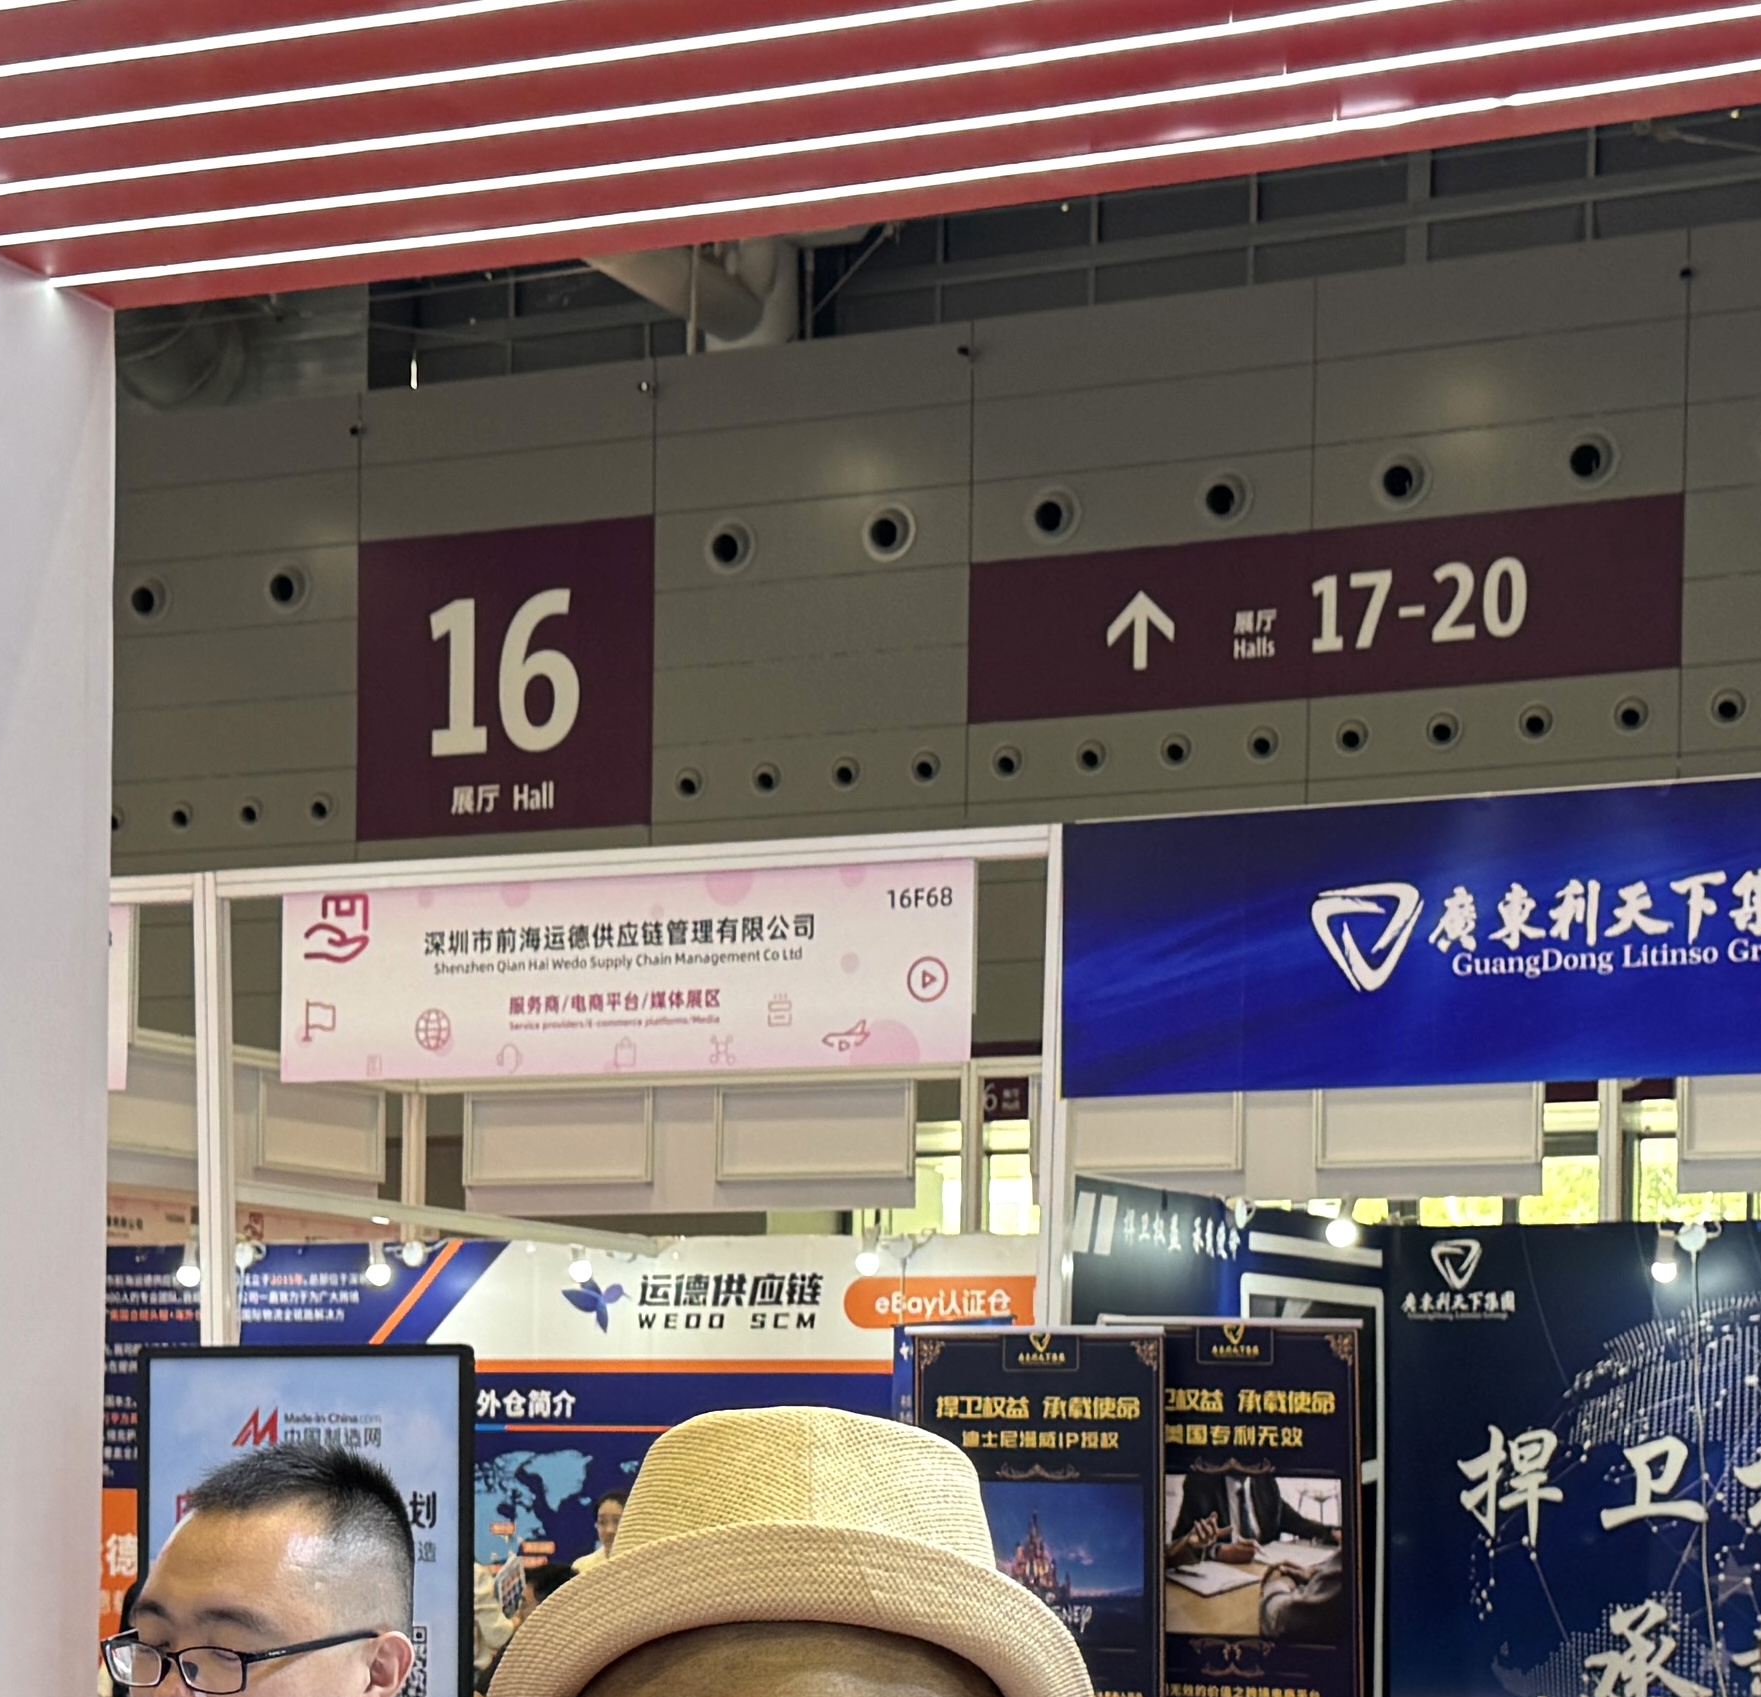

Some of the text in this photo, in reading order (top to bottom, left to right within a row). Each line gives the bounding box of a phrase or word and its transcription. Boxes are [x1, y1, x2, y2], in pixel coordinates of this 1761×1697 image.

[1311, 556, 1528, 653] 17-20
[1233, 637, 1276, 660] Halls
[428, 588, 581, 756] 16
[451, 779, 555, 814] 展厅 Hall
[887, 886, 953, 911] 16F68
[424, 913, 816, 956] 深圳市前海运德供应链管理有限公司
[434, 960, 495, 975] Shenzhen
[589, 955, 633, 971] Supply
[635, 953, 671, 968] Chain
[674, 949, 761, 967] Management
[1451, 941, 1615, 981] GuangDong
[1622, 941, 1719, 970] Litinso
[638, 1272, 823, 1308] 运德供应链
[875, 1289, 1011, 1318] eBay认证仓
[750, 1312, 817, 1330] SCM
[284, 1427, 382, 1448] 中国制造网
